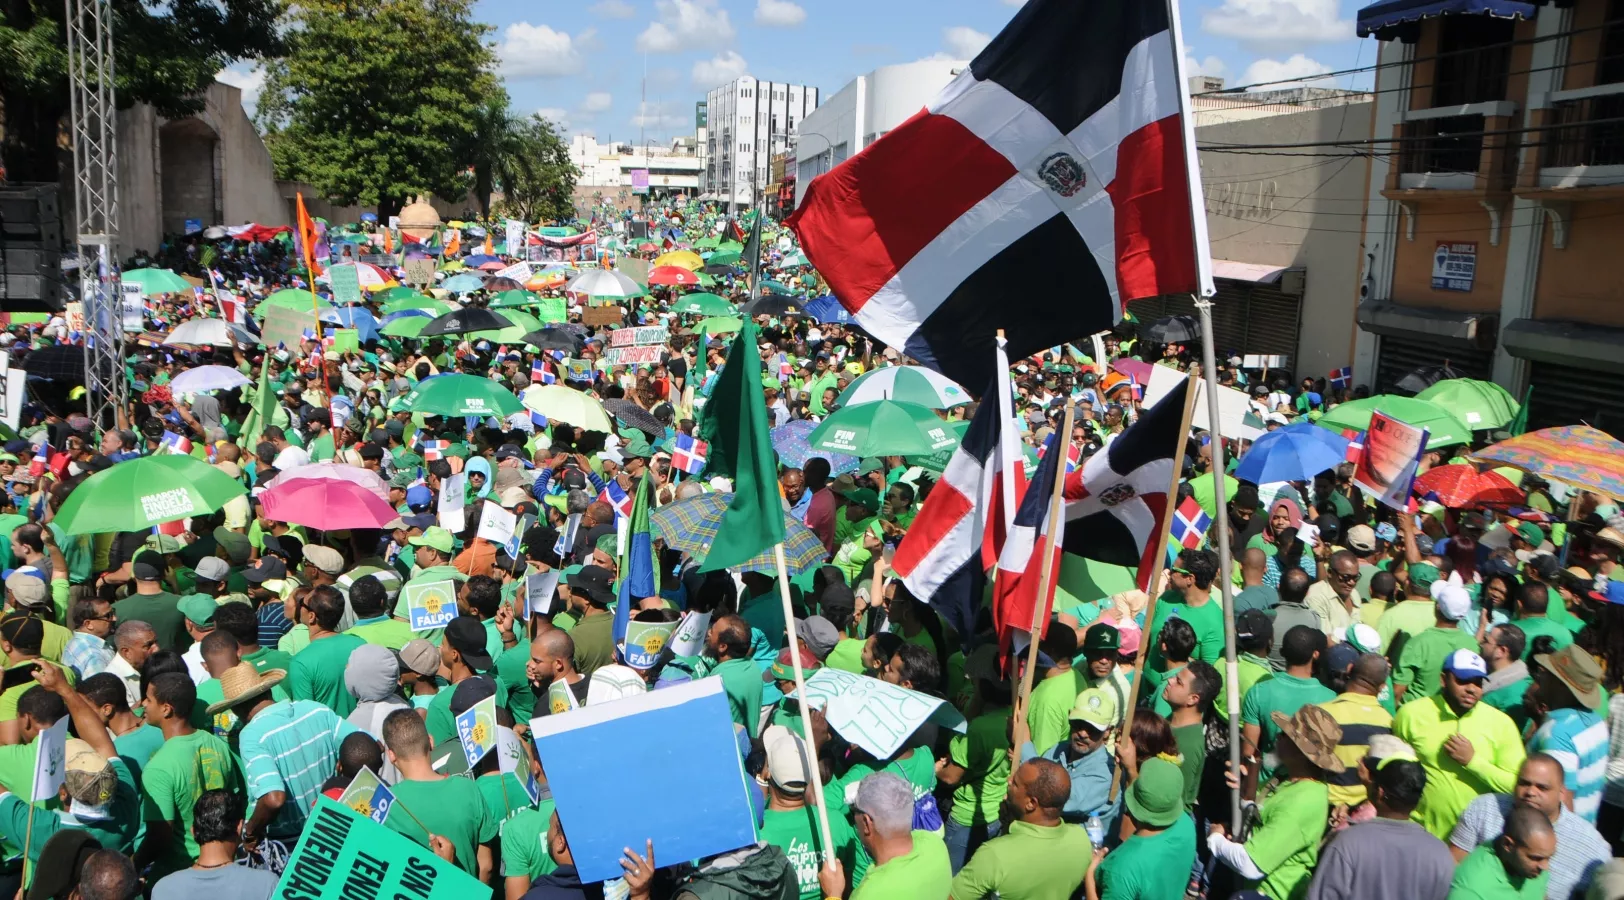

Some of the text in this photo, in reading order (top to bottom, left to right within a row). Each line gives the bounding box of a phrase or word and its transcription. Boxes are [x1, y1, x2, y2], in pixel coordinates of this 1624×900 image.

[465, 398, 484, 406] FIN
[834, 429, 856, 441] FIN
[928, 427, 946, 440] FIN
[146, 504, 194, 521] IMPUNIDAD
[416, 612, 454, 627] FALPO
[459, 718, 478, 766] FALPO
[282, 806, 354, 900] VIVIENDAS
[788, 837, 808, 855] Los
[787, 850, 827, 867] RUPTOS
[339, 851, 389, 900] TEND
[400, 856, 437, 899] SIN
